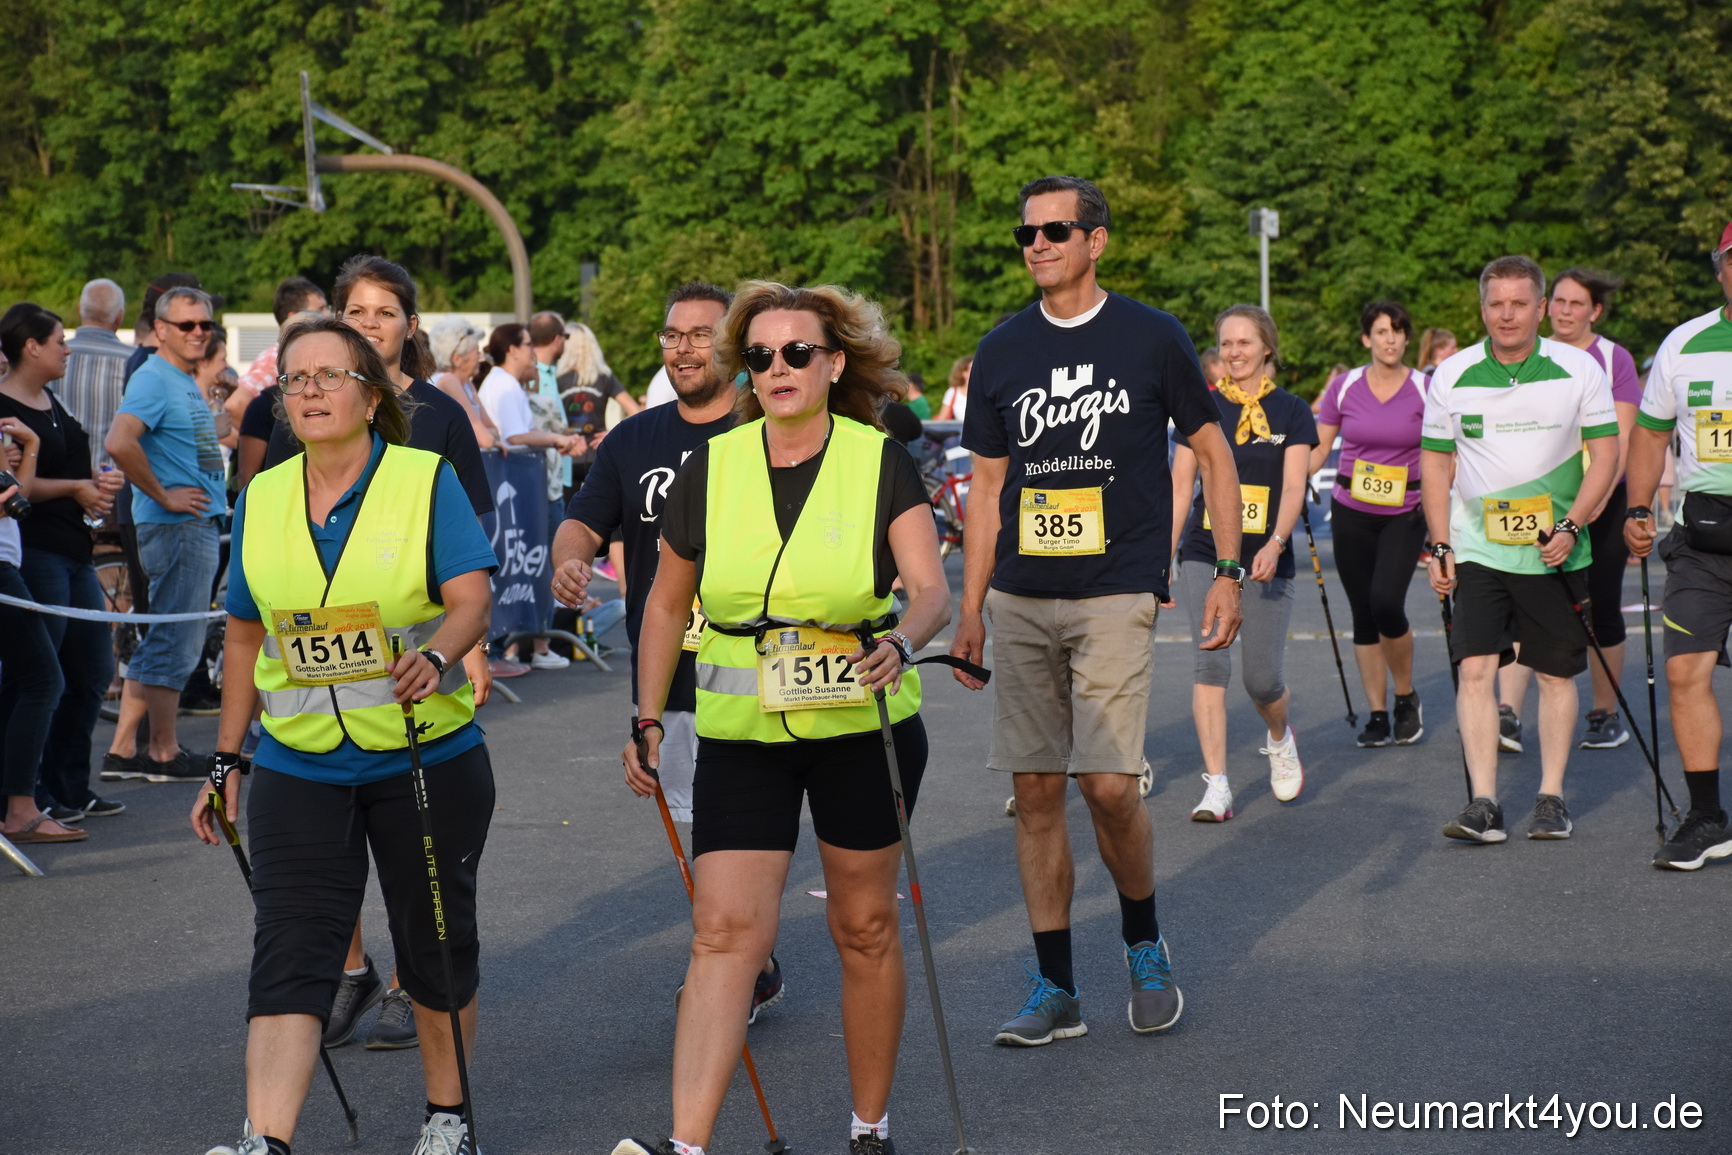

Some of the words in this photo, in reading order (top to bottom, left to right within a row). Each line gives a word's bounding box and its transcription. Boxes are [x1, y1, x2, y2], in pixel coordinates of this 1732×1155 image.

[1688, 389, 1712, 397] BayWa
[1012, 378, 1130, 451] Burgis
[1025, 455, 1116, 476] Knödelliebe.
[1363, 477, 1393, 494] 639
[1034, 513, 1083, 537] 385
[1500, 514, 1538, 532] 123
[1038, 538, 1060, 546] Burger
[289, 622, 328, 632] firmenlauf
[334, 623, 354, 633] walk
[355, 622, 375, 632] 2019
[290, 631, 373, 664] 1514
[773, 641, 816, 653] firmenlauf
[821, 645, 839, 654] walk
[295, 665, 337, 673] Gottschalk
[339, 658, 377, 670] Christine
[322, 667, 367, 678] Postbauer-Heng
[771, 655, 855, 687] 1512
[779, 687, 813, 697] Gottlieb
[815, 685, 851, 695] Susanne
[801, 693, 847, 701] Postbauer-Heng
[423, 836, 438, 878] ELITE
[430, 881, 447, 941] CARBON
